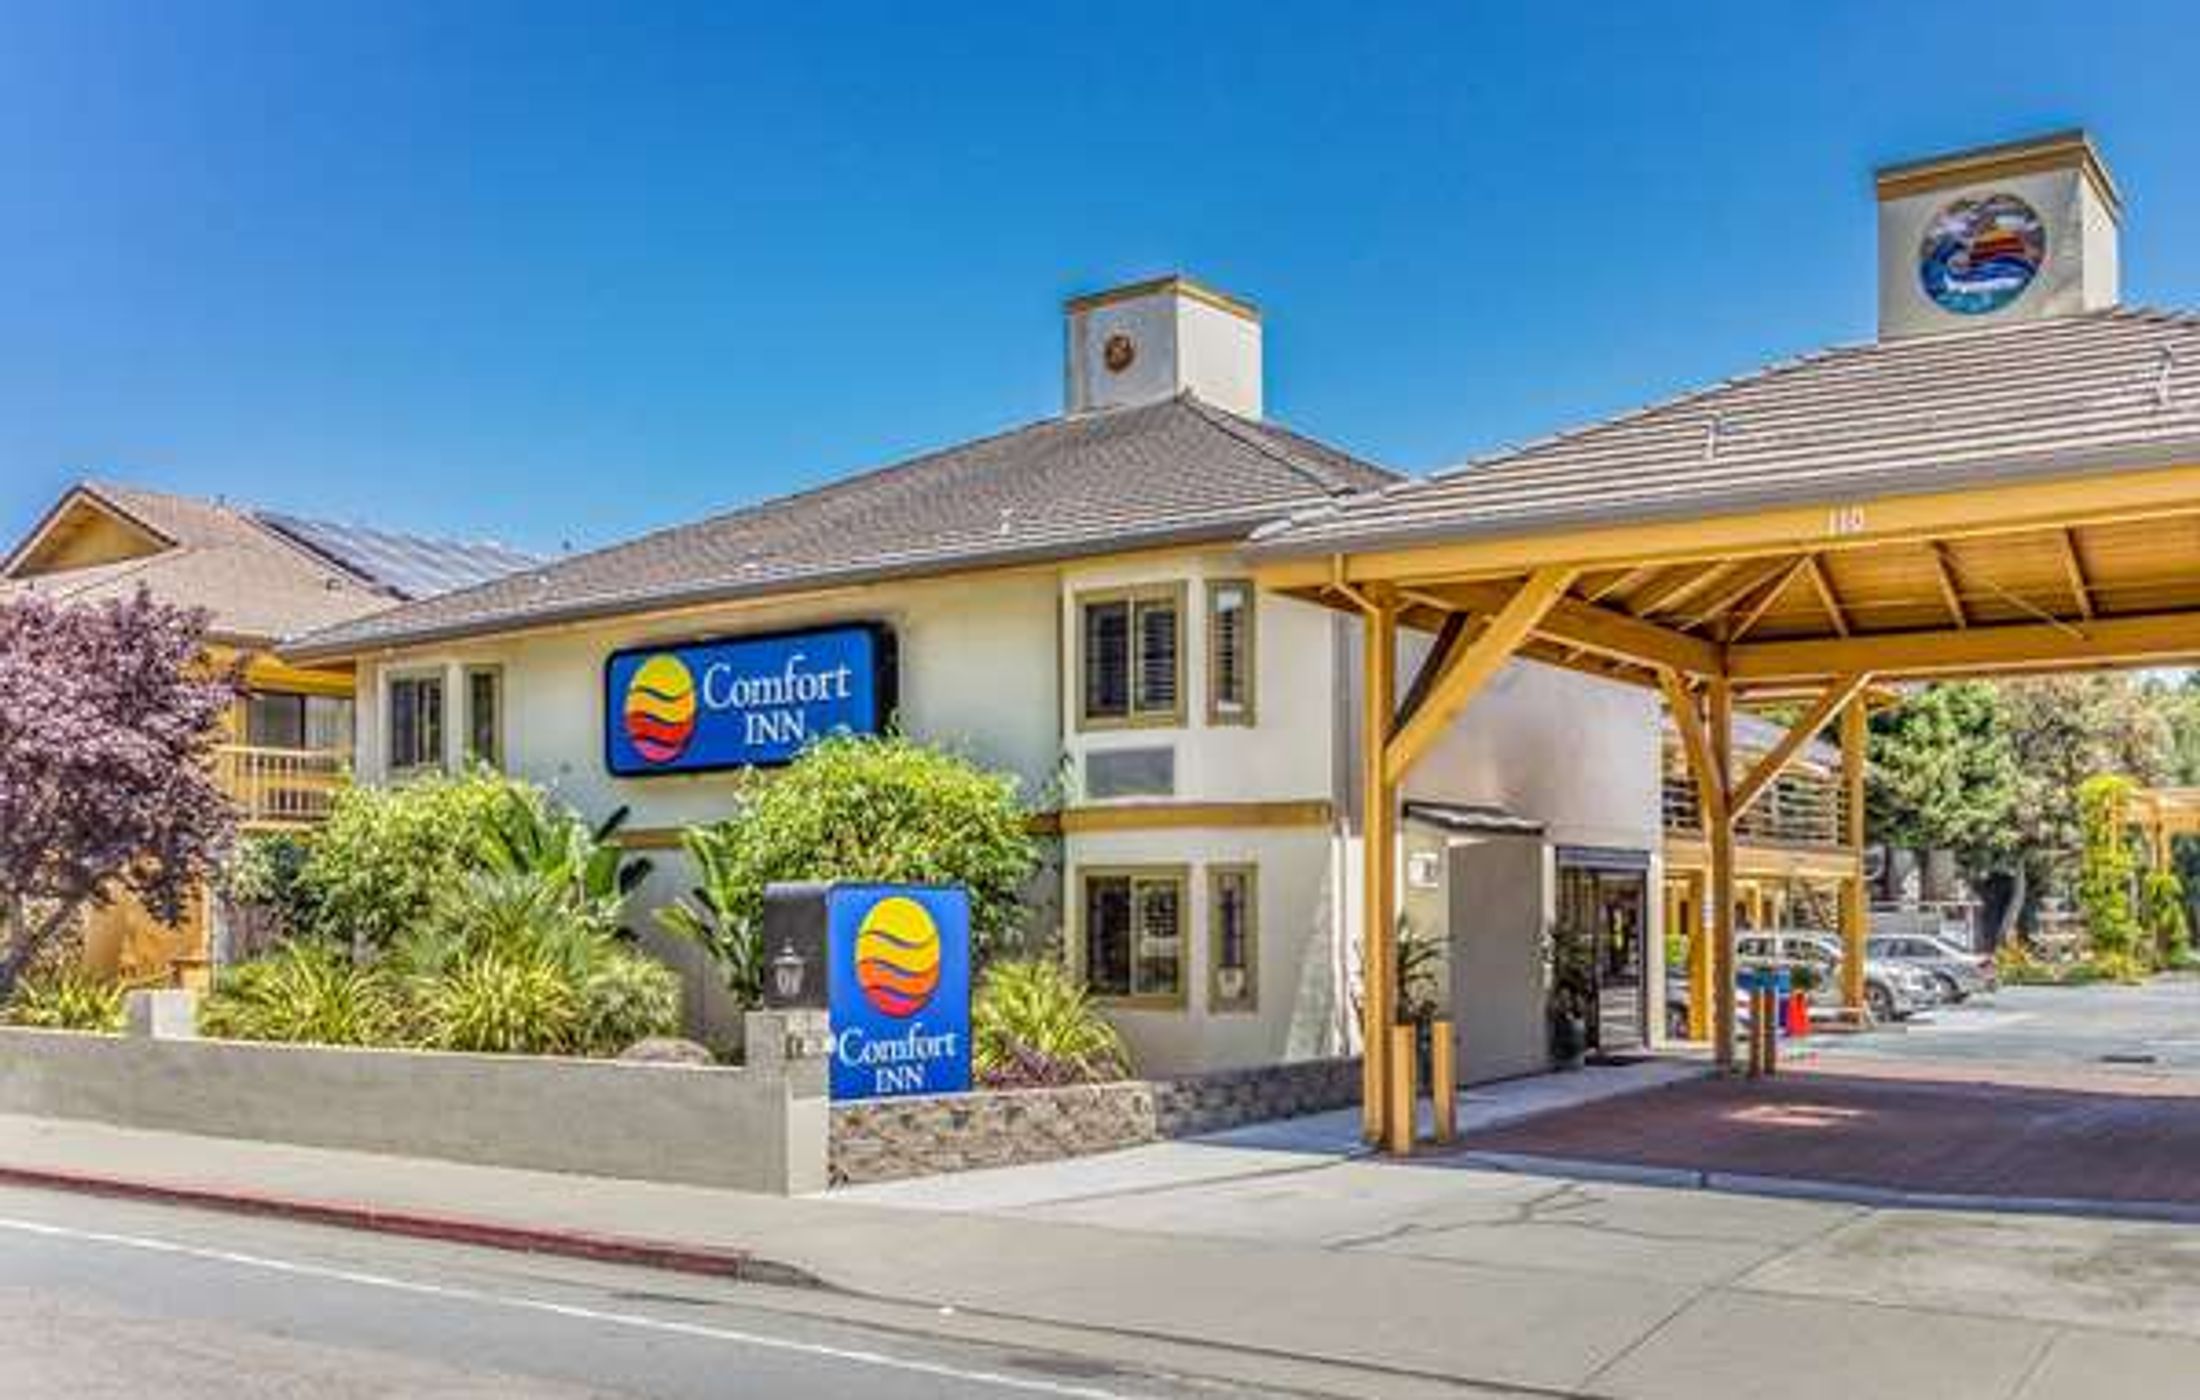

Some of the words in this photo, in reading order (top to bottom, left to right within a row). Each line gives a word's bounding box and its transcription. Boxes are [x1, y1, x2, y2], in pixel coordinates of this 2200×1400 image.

[703, 654, 852, 709] Comfort
[746, 707, 804, 745] INN
[839, 1022, 959, 1067] Comfort
[876, 1063, 924, 1093] INN
